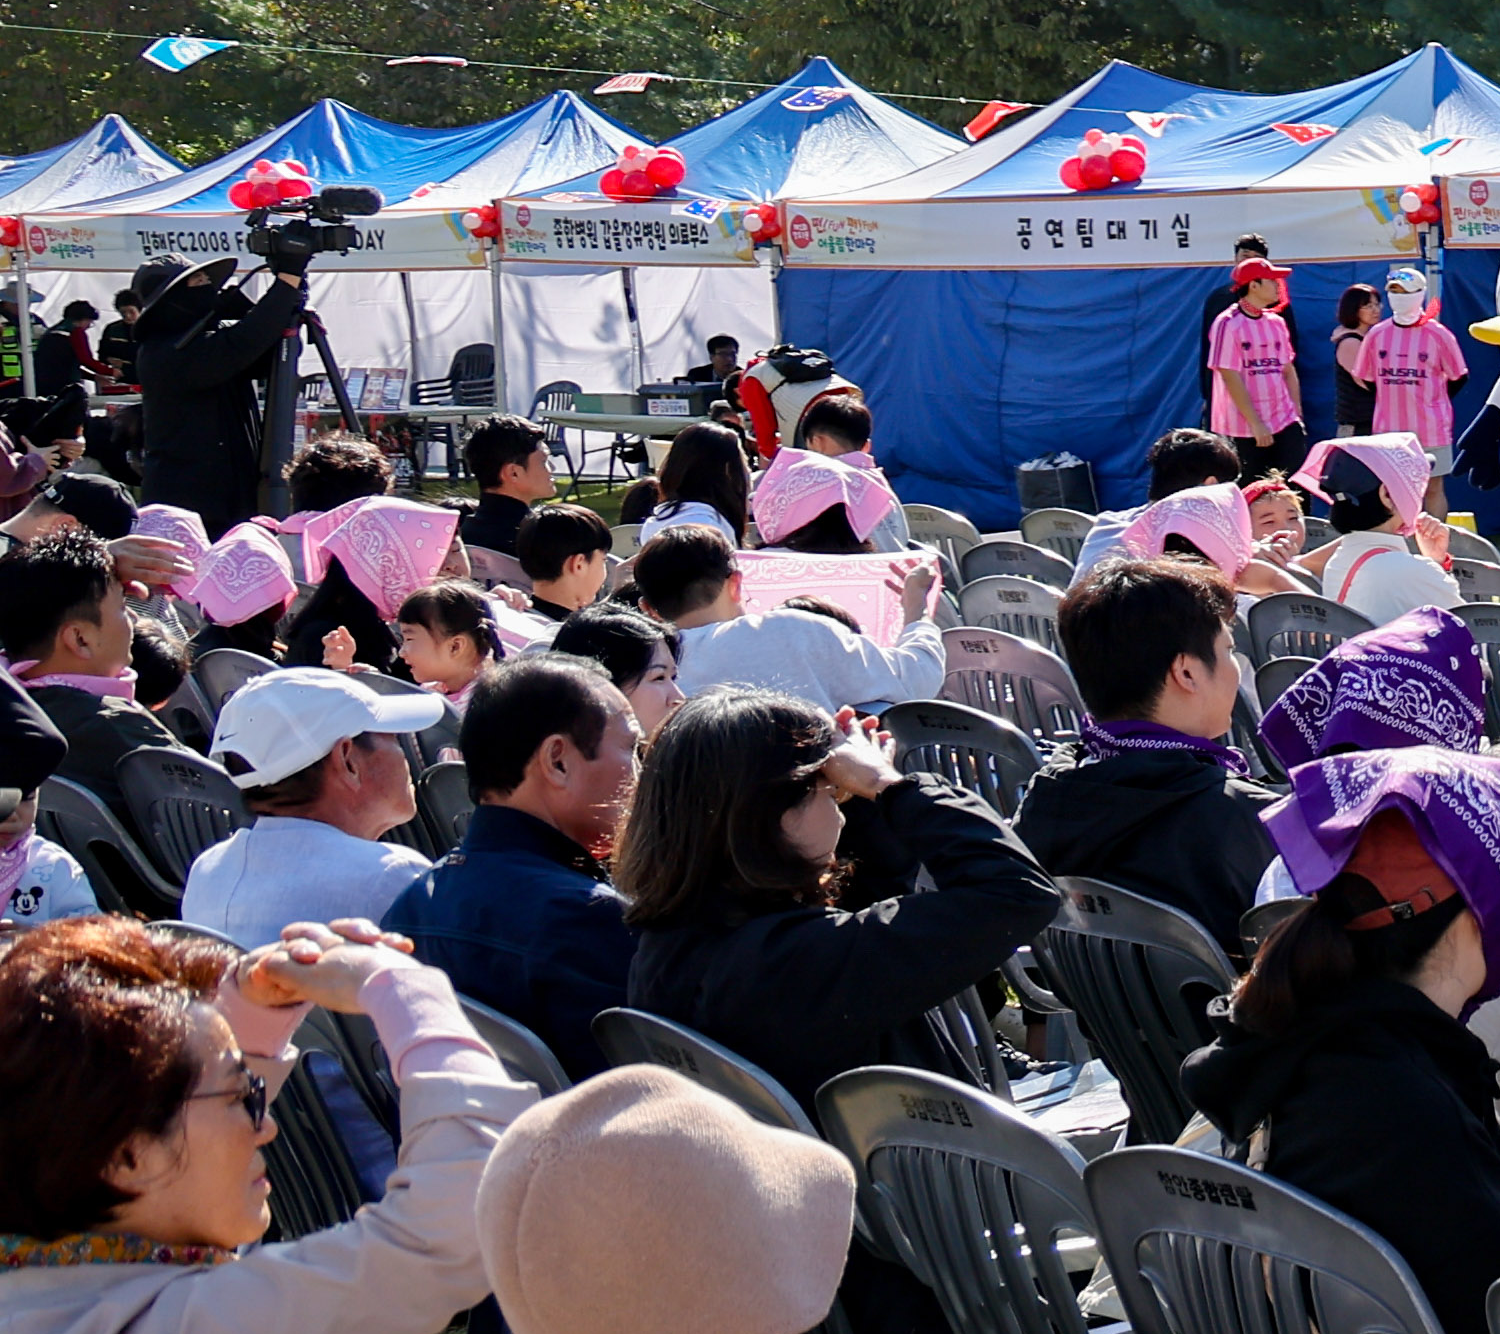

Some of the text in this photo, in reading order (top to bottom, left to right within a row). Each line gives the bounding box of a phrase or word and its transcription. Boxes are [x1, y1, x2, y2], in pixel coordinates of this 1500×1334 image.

[136, 230, 230, 256] 김해FC2008
[553, 217, 598, 249] 종합병원
[599, 219, 667, 253] 갑을장유병원
[669, 222, 710, 248] 의료부스
[1156, 1169, 1259, 1212] 함안종합렌탈
